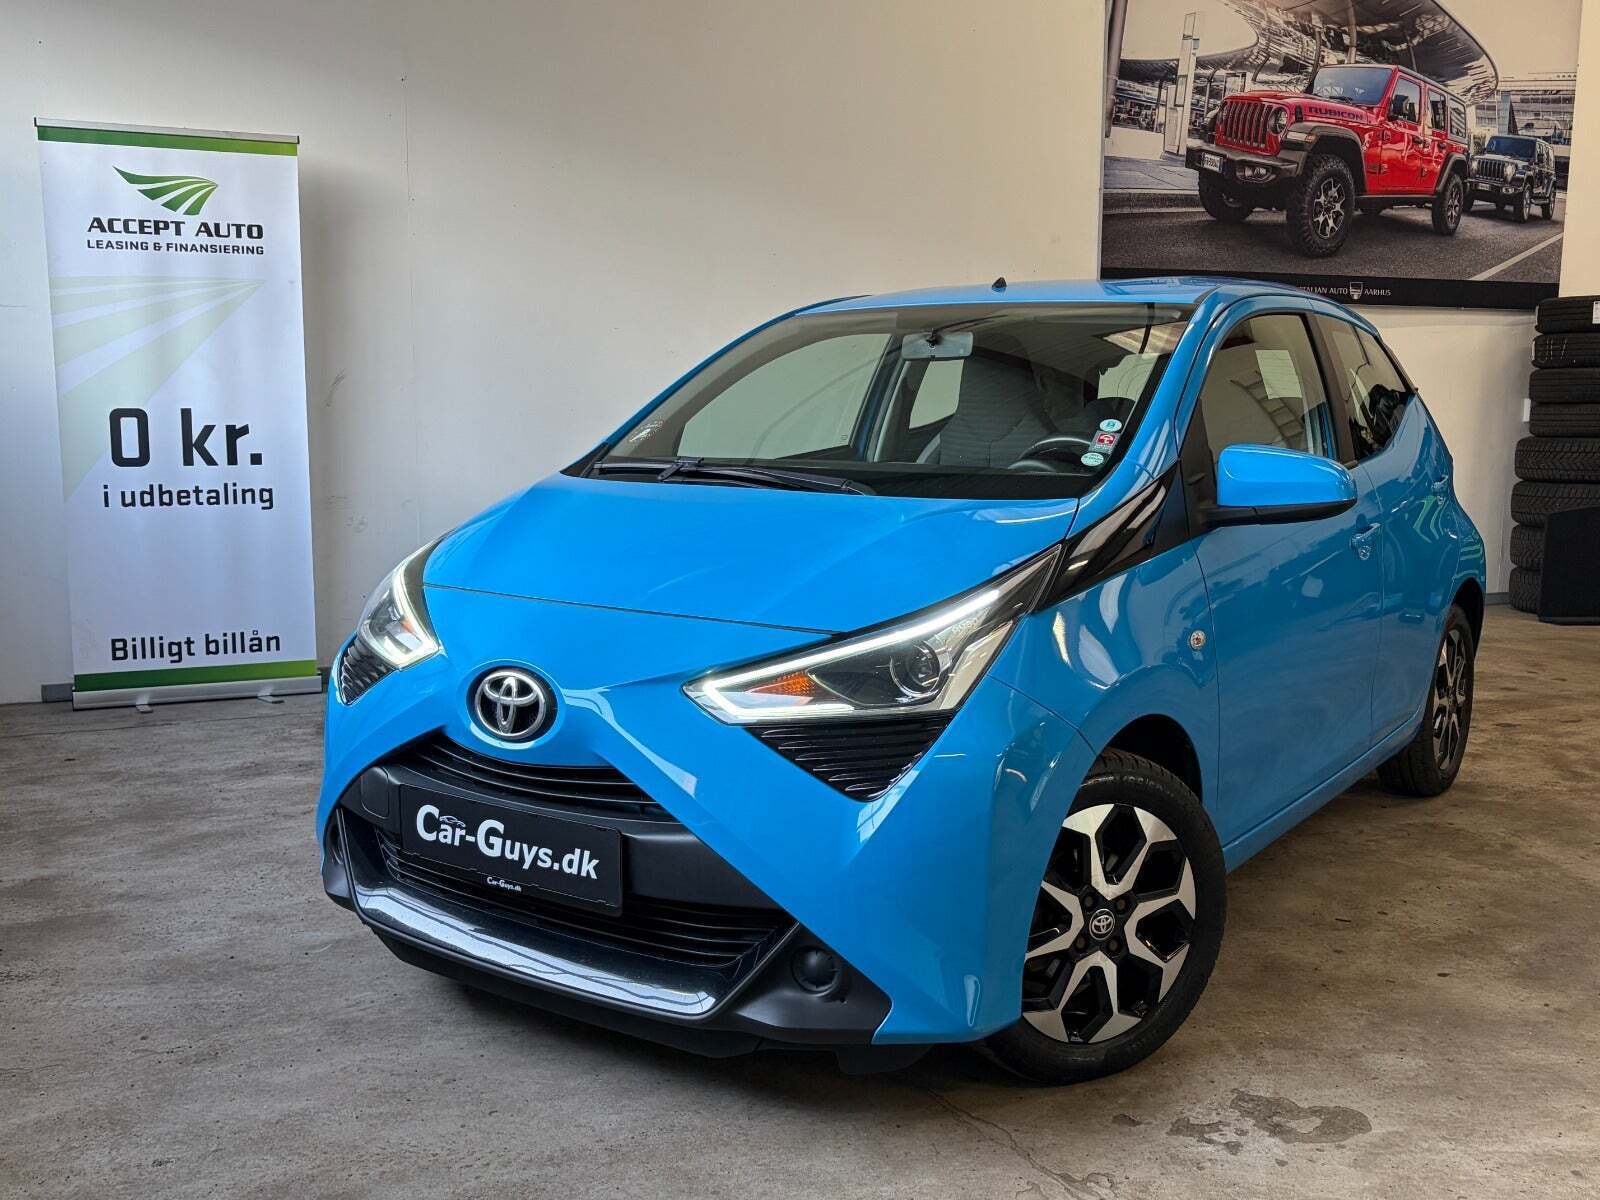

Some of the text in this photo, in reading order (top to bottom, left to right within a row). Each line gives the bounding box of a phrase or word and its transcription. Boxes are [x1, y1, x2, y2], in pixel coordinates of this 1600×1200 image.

[1308, 106, 1363, 120] RUBICON
[87, 217, 264, 239] ACCEPT AUTO
[87, 239, 264, 255] LEASING & FINANSIERING
[1329, 287, 1348, 295] AUTO
[1364, 288, 1392, 296] AARHUS
[109, 408, 263, 467] 0 kr.
[103, 482, 274, 510] i udbetaling
[111, 630, 281, 663] Billigt billån
[416, 804, 599, 879] Car-Guys.dk
